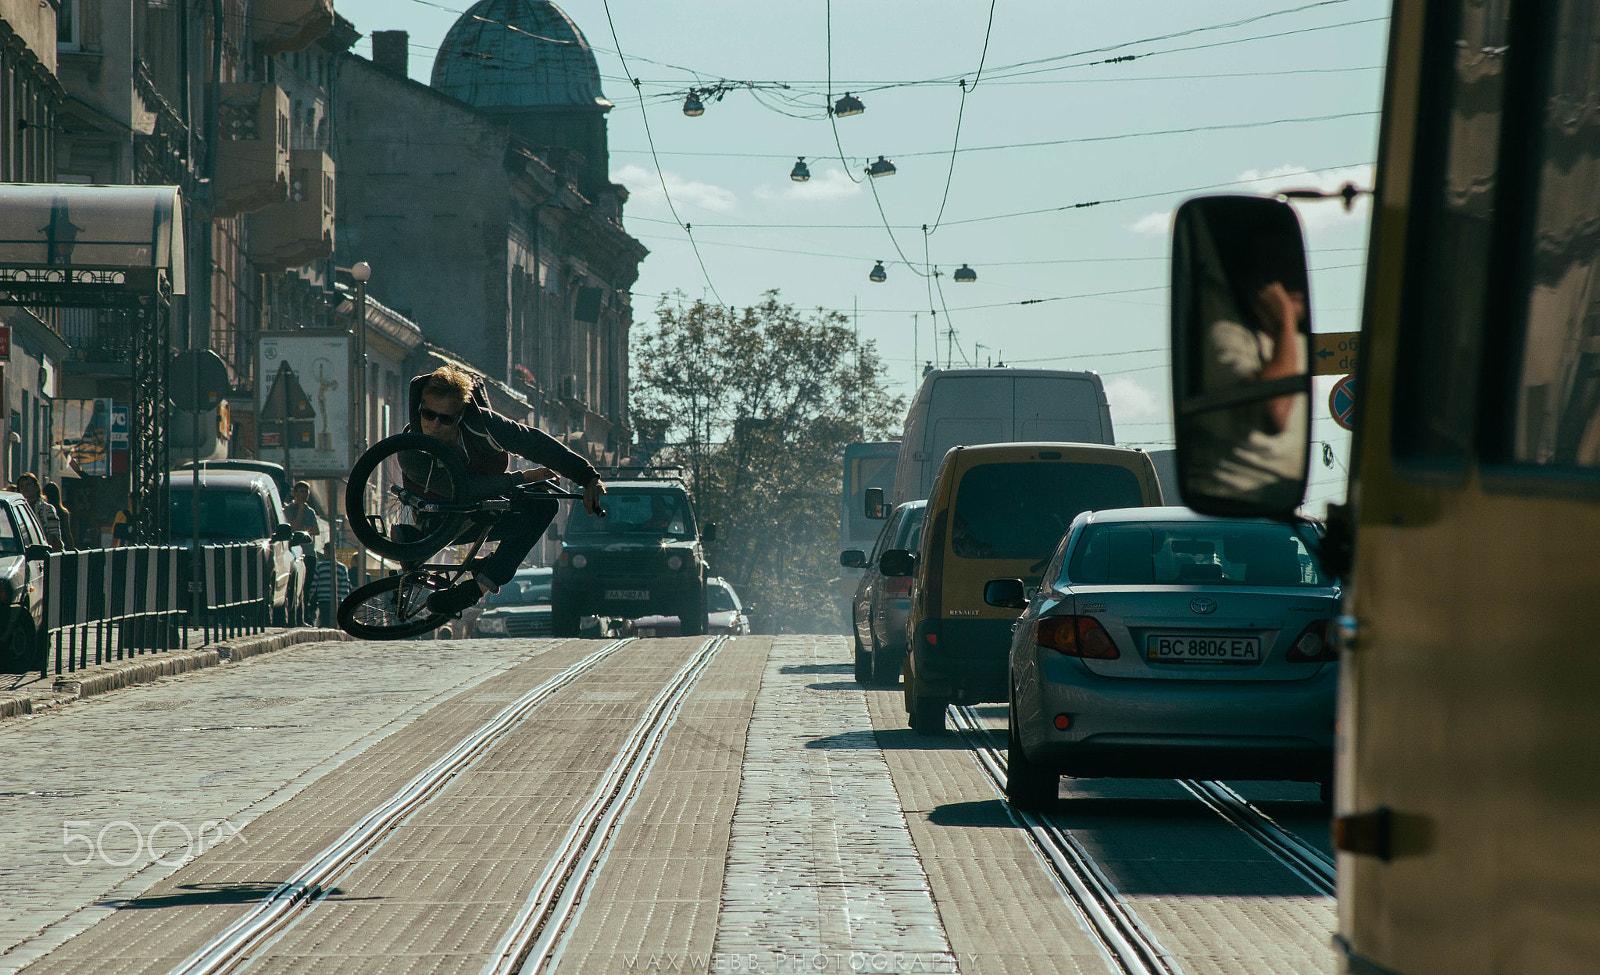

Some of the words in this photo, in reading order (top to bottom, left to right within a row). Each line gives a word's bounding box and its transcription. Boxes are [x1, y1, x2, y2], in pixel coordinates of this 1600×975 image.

[1159, 639, 1184, 656] BC
[1188, 640, 1227, 657] 8806
[1231, 641, 1255, 658] EA
